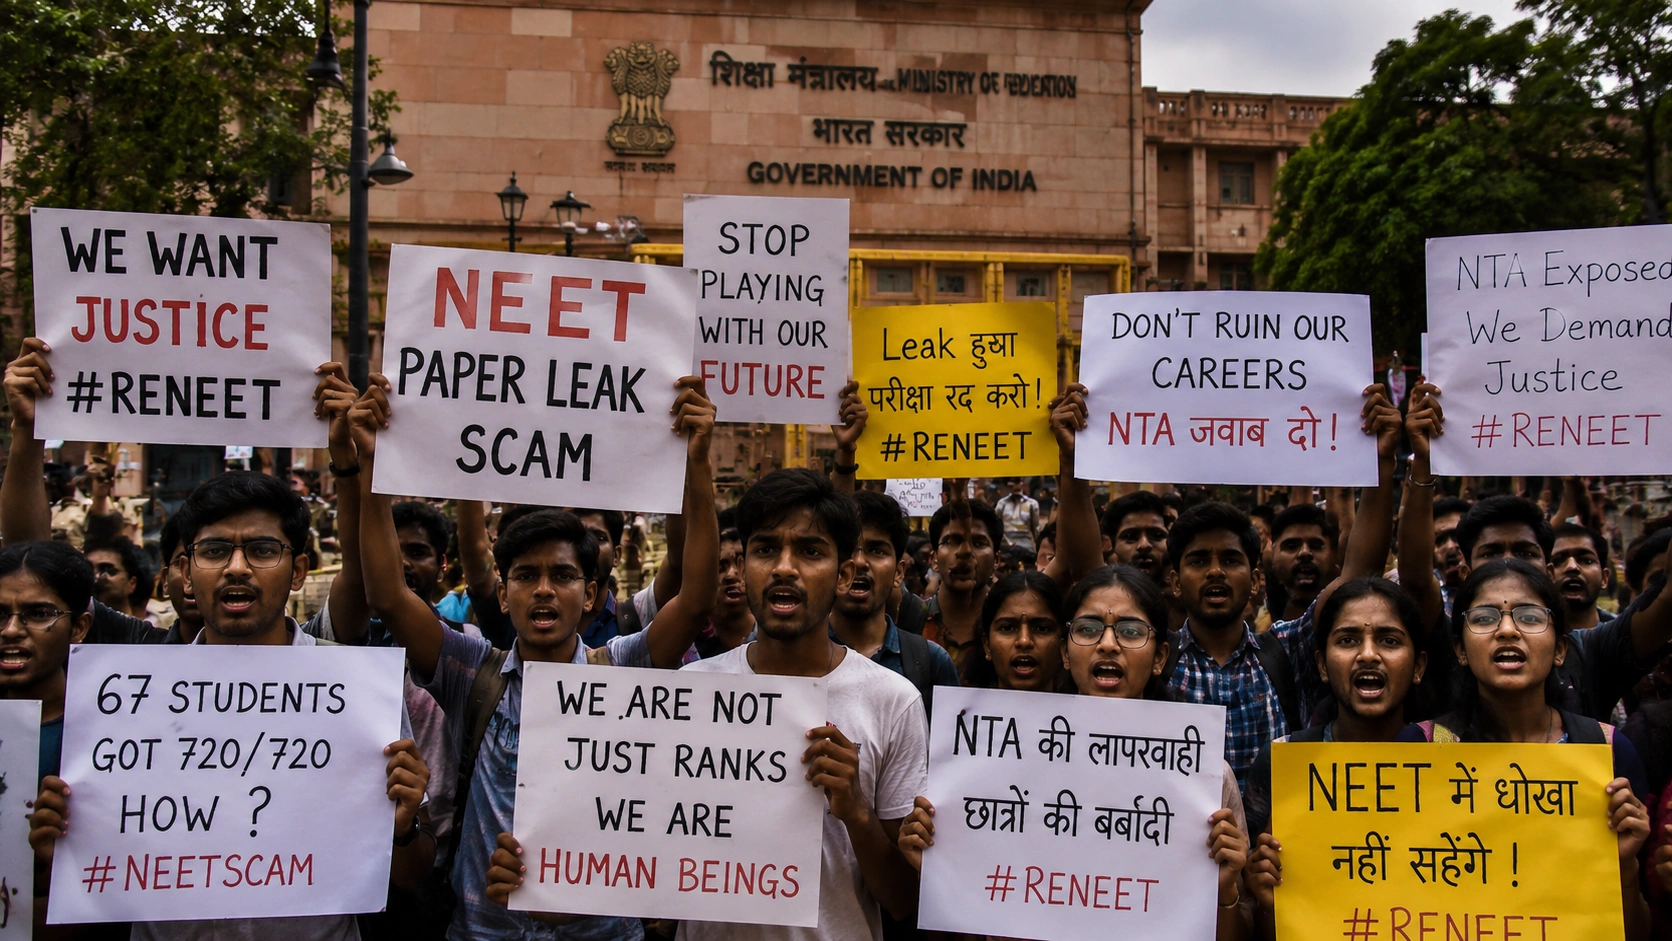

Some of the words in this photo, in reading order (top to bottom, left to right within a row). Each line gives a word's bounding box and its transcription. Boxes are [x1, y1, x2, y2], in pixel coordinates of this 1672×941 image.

[709, 49, 777, 89] शिक्षा
[812, 118, 875, 146] भारत
[883, 120, 968, 149] सरकार
[746, 160, 923, 190] GOVERNMENT
[930, 166, 964, 191] OF
[971, 168, 1038, 195] INDIA
[60, 226, 127, 275] WE
[146, 230, 279, 280] WANT
[717, 221, 810, 257] STOP
[701, 269, 825, 307] PLAYING
[1457, 253, 1527, 291] NTA
[71, 296, 269, 351] JUSTICE
[433, 266, 647, 343] NEET
[1111, 307, 1201, 340] DON'T
[1215, 311, 1281, 340] RUIN
[1293, 314, 1350, 343] OUR
[1466, 309, 1521, 345] We
[1539, 301, 1672, 342] Demand
[698, 316, 764, 346] WITH
[777, 319, 829, 349] OUR
[882, 327, 957, 362] Leak
[397, 346, 526, 405] PAPER
[546, 359, 647, 414] LEAK
[701, 360, 825, 399] FUTURE
[1151, 356, 1307, 391] CAREERS
[1484, 357, 1623, 396] Justice
[66, 371, 281, 421] #RENEET
[867, 376, 934, 414] परीक्षा
[944, 384, 976, 414] रद
[879, 431, 1033, 463] #RENEET
[1107, 411, 1176, 446] NTA
[1189, 417, 1270, 448] जवाब
[1470, 412, 1662, 449] #RENEET
[455, 423, 593, 482] SCAM
[97, 673, 152, 715] 67
[168, 680, 346, 715] STUDENTS
[556, 680, 608, 717] WE
[625, 684, 693, 721] ARE
[712, 690, 783, 726] NOT
[92, 737, 163, 774] GOT
[178, 731, 332, 778] 720/720
[564, 737, 656, 775] JUST
[674, 743, 787, 784] RANKS
[952, 712, 1023, 760] NTA
[1038, 715, 1076, 763] की
[1088, 724, 1206, 777] लापरवाही
[1308, 762, 1432, 813] NEET
[1448, 761, 1479, 814] में
[1494, 762, 1579, 817] धोखा
[119, 794, 220, 834] HOW
[248, 785, 272, 838] ?
[595, 796, 646, 833] WE
[666, 802, 734, 838] ARE
[962, 784, 1030, 834] छात्रों
[1043, 789, 1083, 837] की
[1094, 794, 1175, 847] बर्बादी
[81, 853, 314, 894] #NEETSCAM
[539, 847, 657, 890] HUMAN
[677, 857, 800, 900] BEINGS
[1330, 830, 1392, 885] नहीं
[1408, 831, 1493, 888] सहेंगे
[1510, 841, 1520, 888] !
[984, 864, 1160, 913] #RENEET
